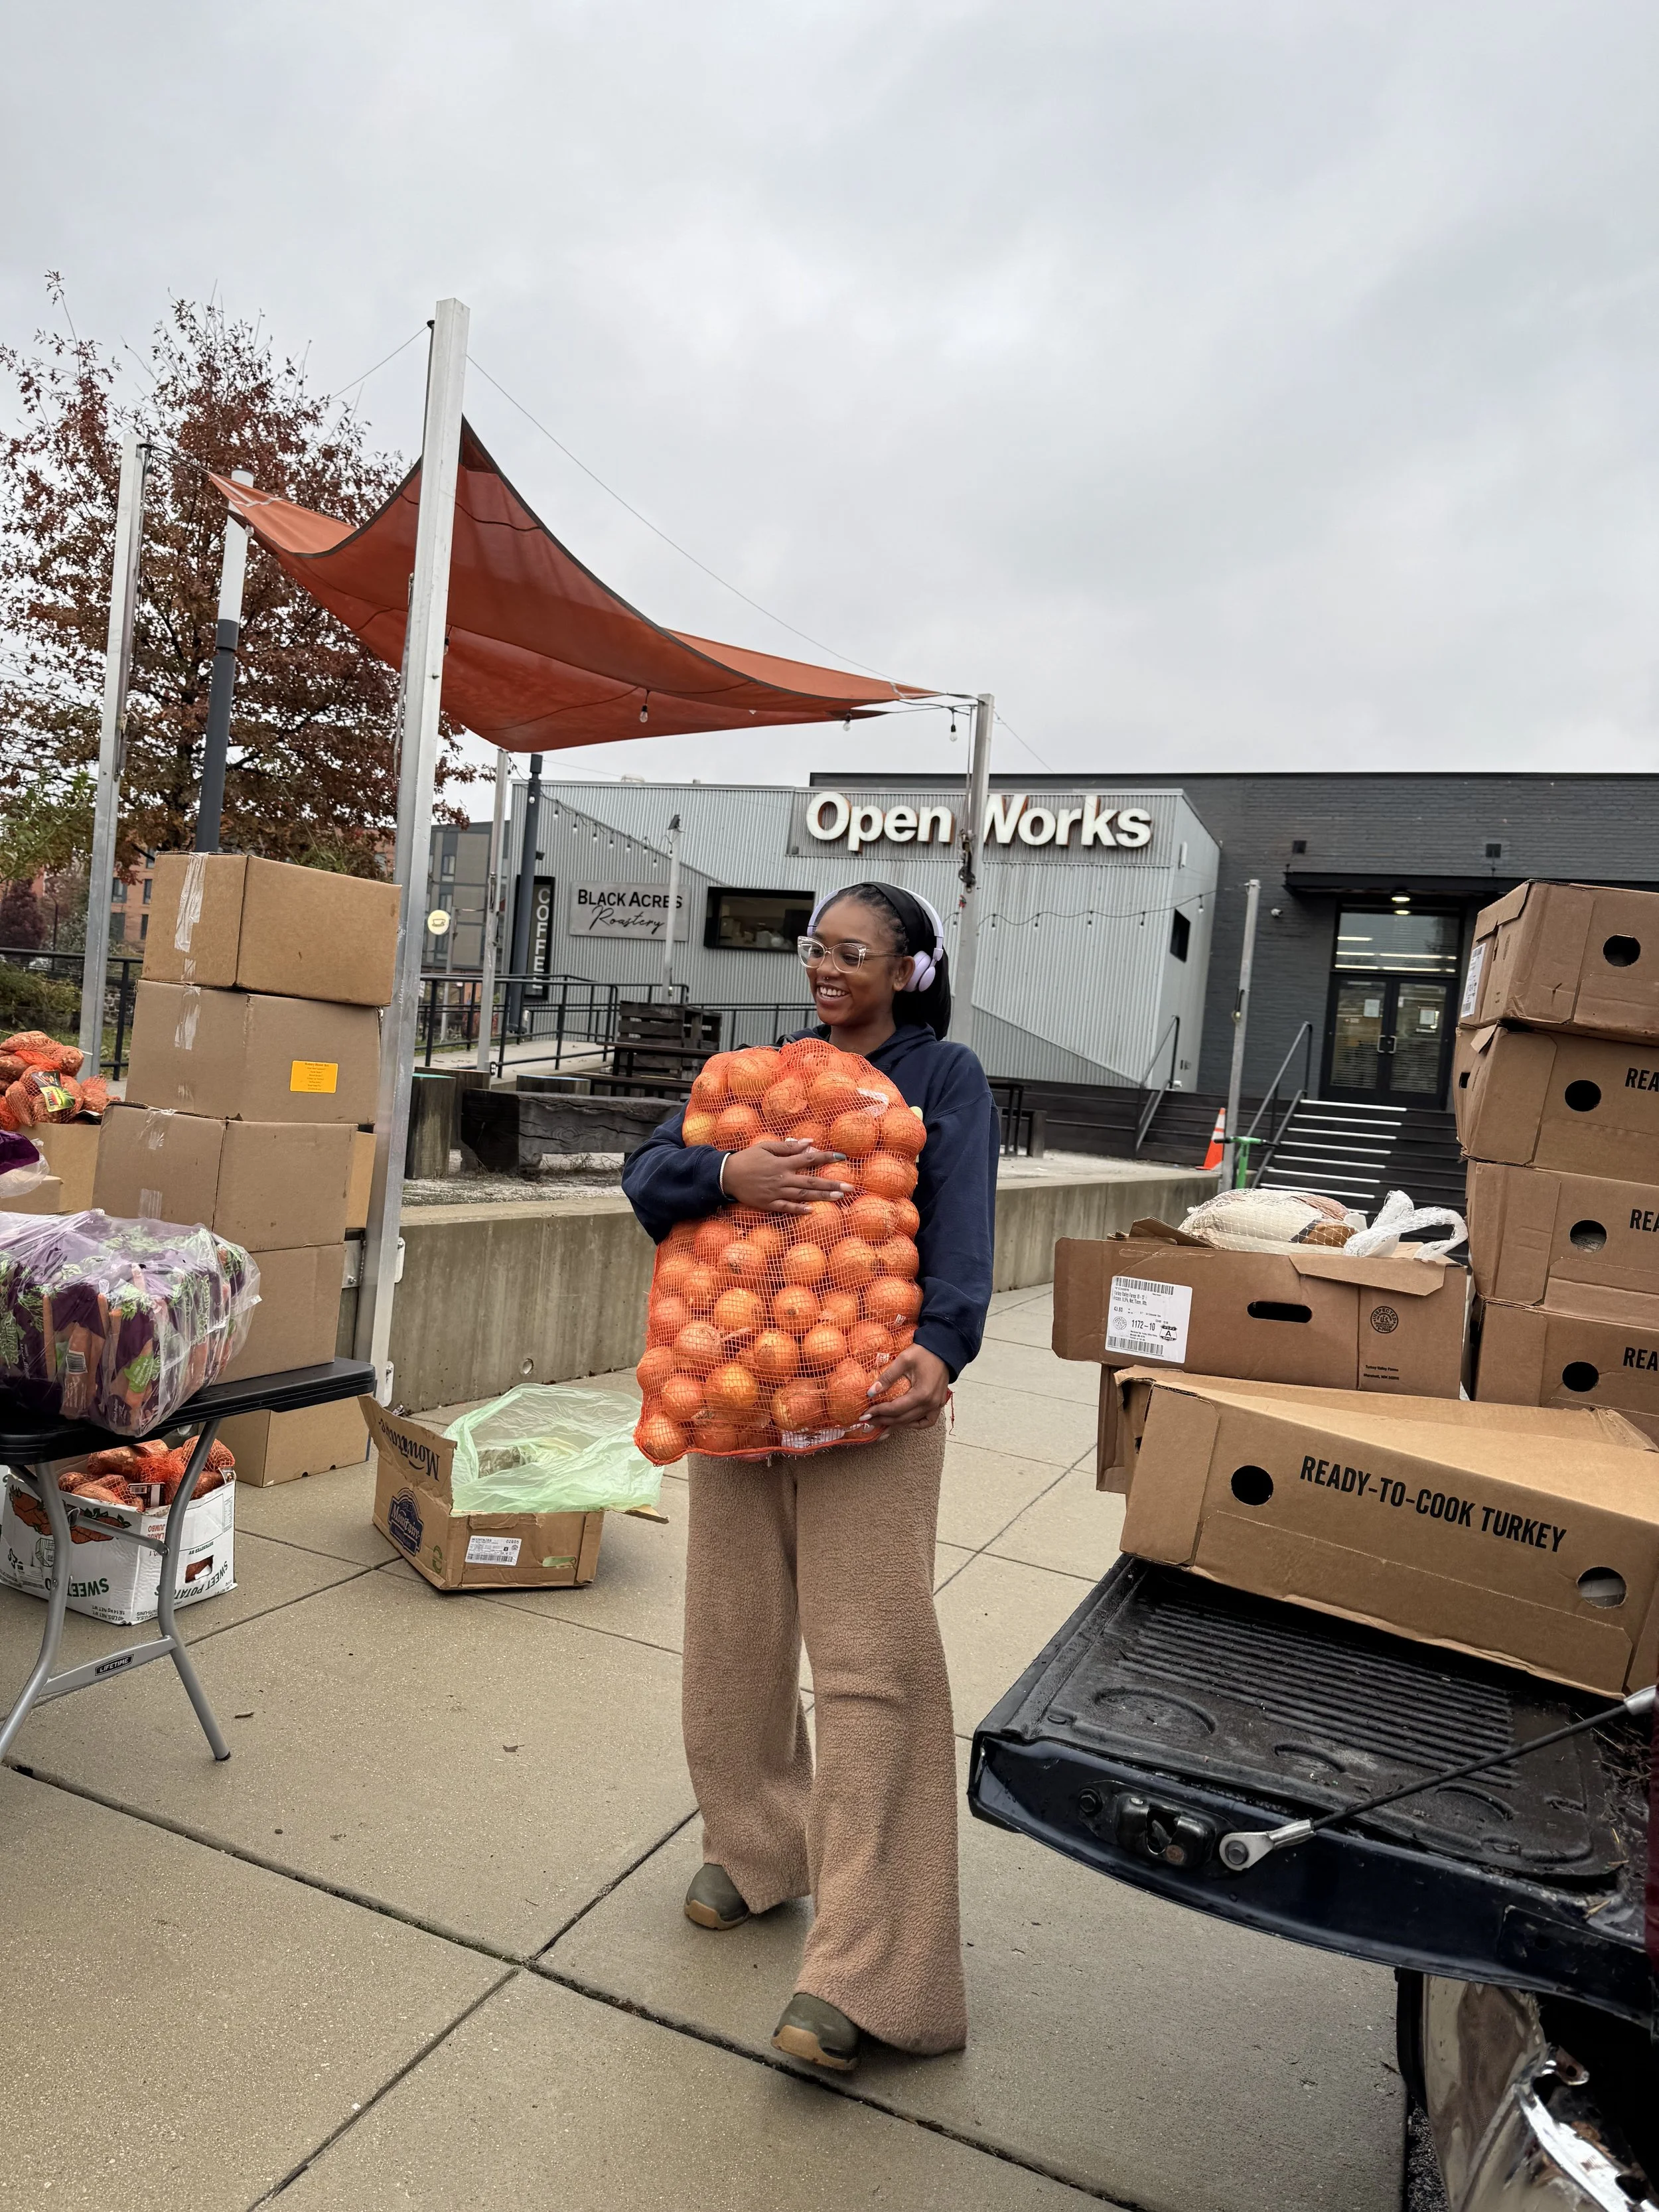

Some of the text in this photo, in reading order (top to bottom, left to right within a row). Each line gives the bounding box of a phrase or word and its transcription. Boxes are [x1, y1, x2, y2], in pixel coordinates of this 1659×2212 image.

[806, 792, 1153, 852] Open Works
[578, 889, 683, 909] BLACK ACRES
[589, 905, 664, 935] Roastery
[1625, 1067, 1659, 1092] REA
[1623, 1347, 1658, 1371] REA
[1300, 1455, 1567, 1552] READY-TO-COOK TURKEY
[148, 1524, 165, 1532] JUMBO
[205, 1560, 228, 1591] SWEET
[154, 1584, 204, 1599] POTATS
[100, 1657, 129, 1672] LIFETIME
